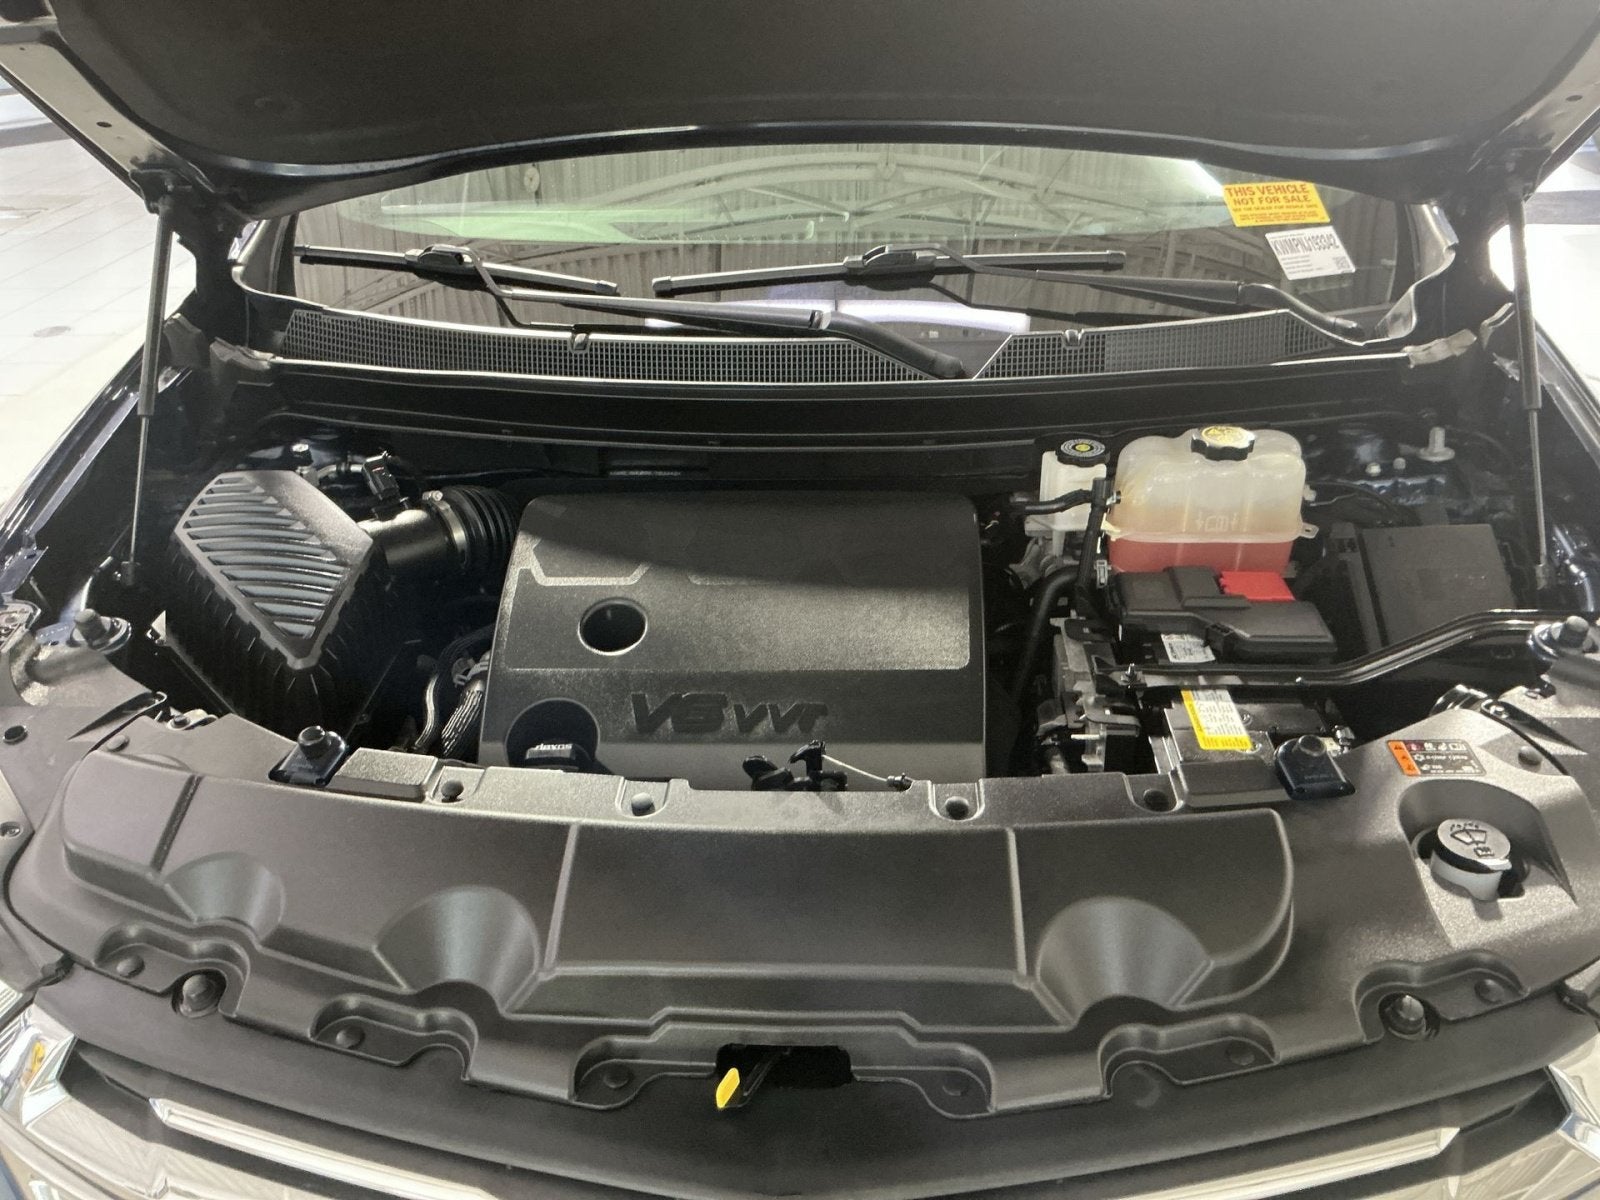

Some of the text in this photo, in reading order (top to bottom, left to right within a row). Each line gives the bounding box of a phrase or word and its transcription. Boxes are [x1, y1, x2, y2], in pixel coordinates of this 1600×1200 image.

[1225, 183, 1310, 197] THIS VEHICLE
[1233, 194, 1312, 207] NOT FOR SALE
[630, 692, 829, 734] V6 VVT
